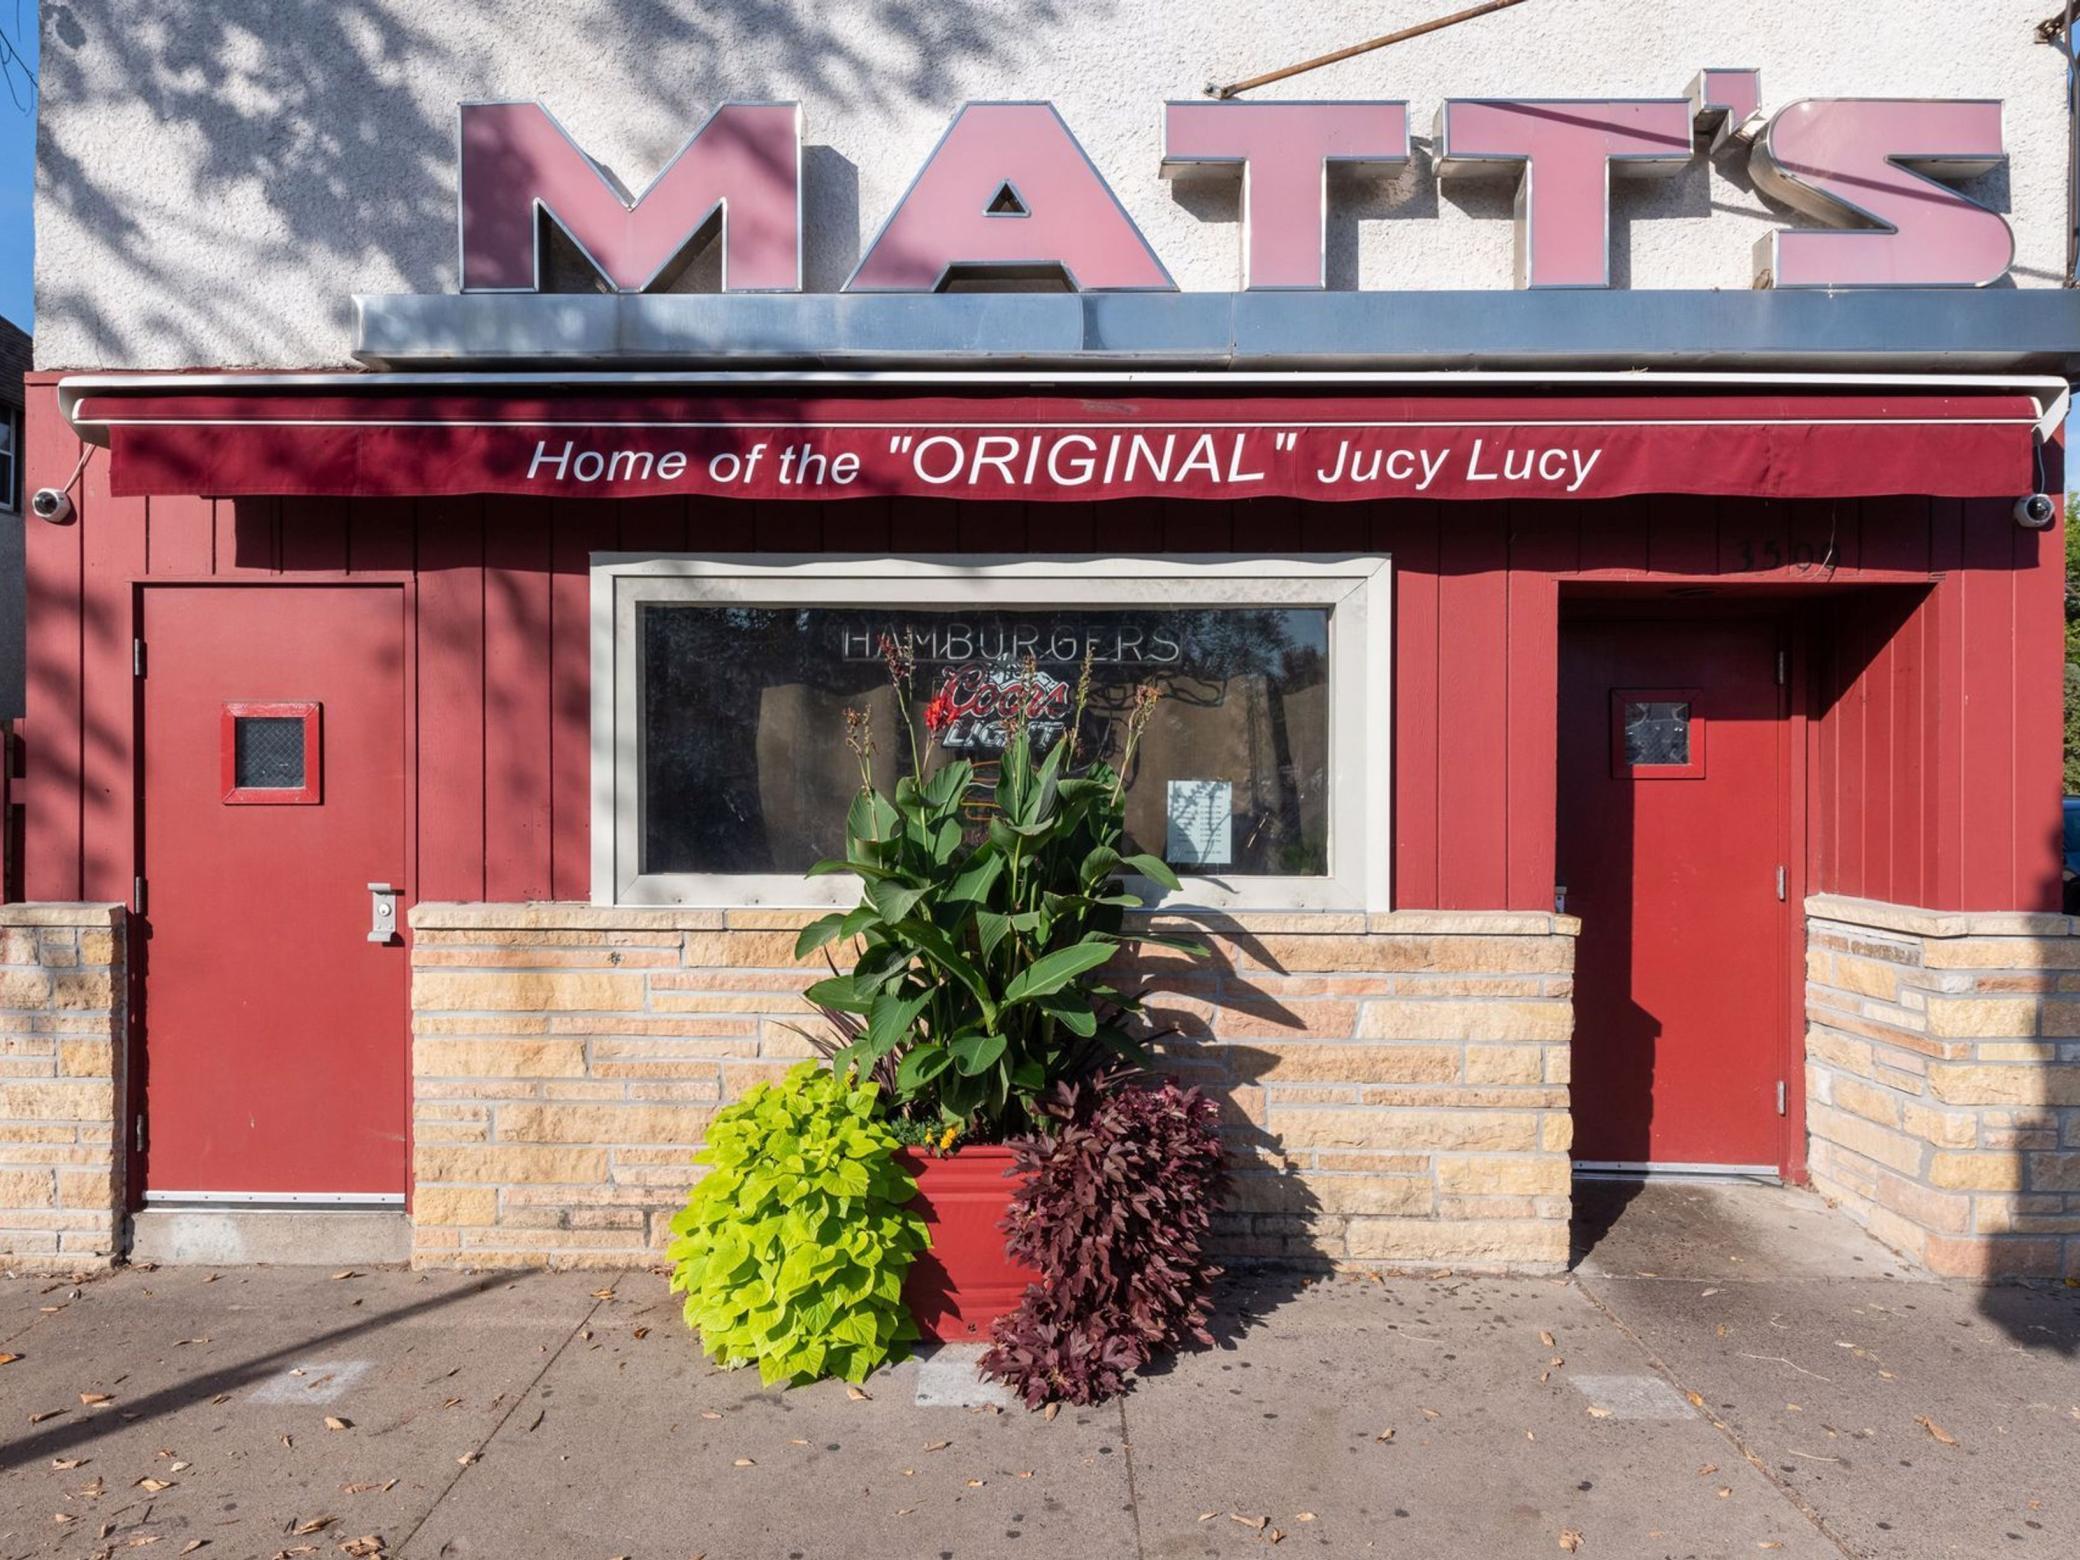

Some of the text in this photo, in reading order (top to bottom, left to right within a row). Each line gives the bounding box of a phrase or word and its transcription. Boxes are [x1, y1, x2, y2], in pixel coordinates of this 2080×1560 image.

[459, 66, 2014, 293] MATT'S
[526, 440, 688, 483] Home
[707, 443, 768, 484] of
[778, 443, 861, 485] the
[1316, 440, 1451, 491] Jucy
[1465, 439, 1603, 492] Lucy
[843, 623, 1182, 662] HAMBURGERS
[940, 660, 1071, 720] Coors
[942, 719, 1066, 749] LIGT
